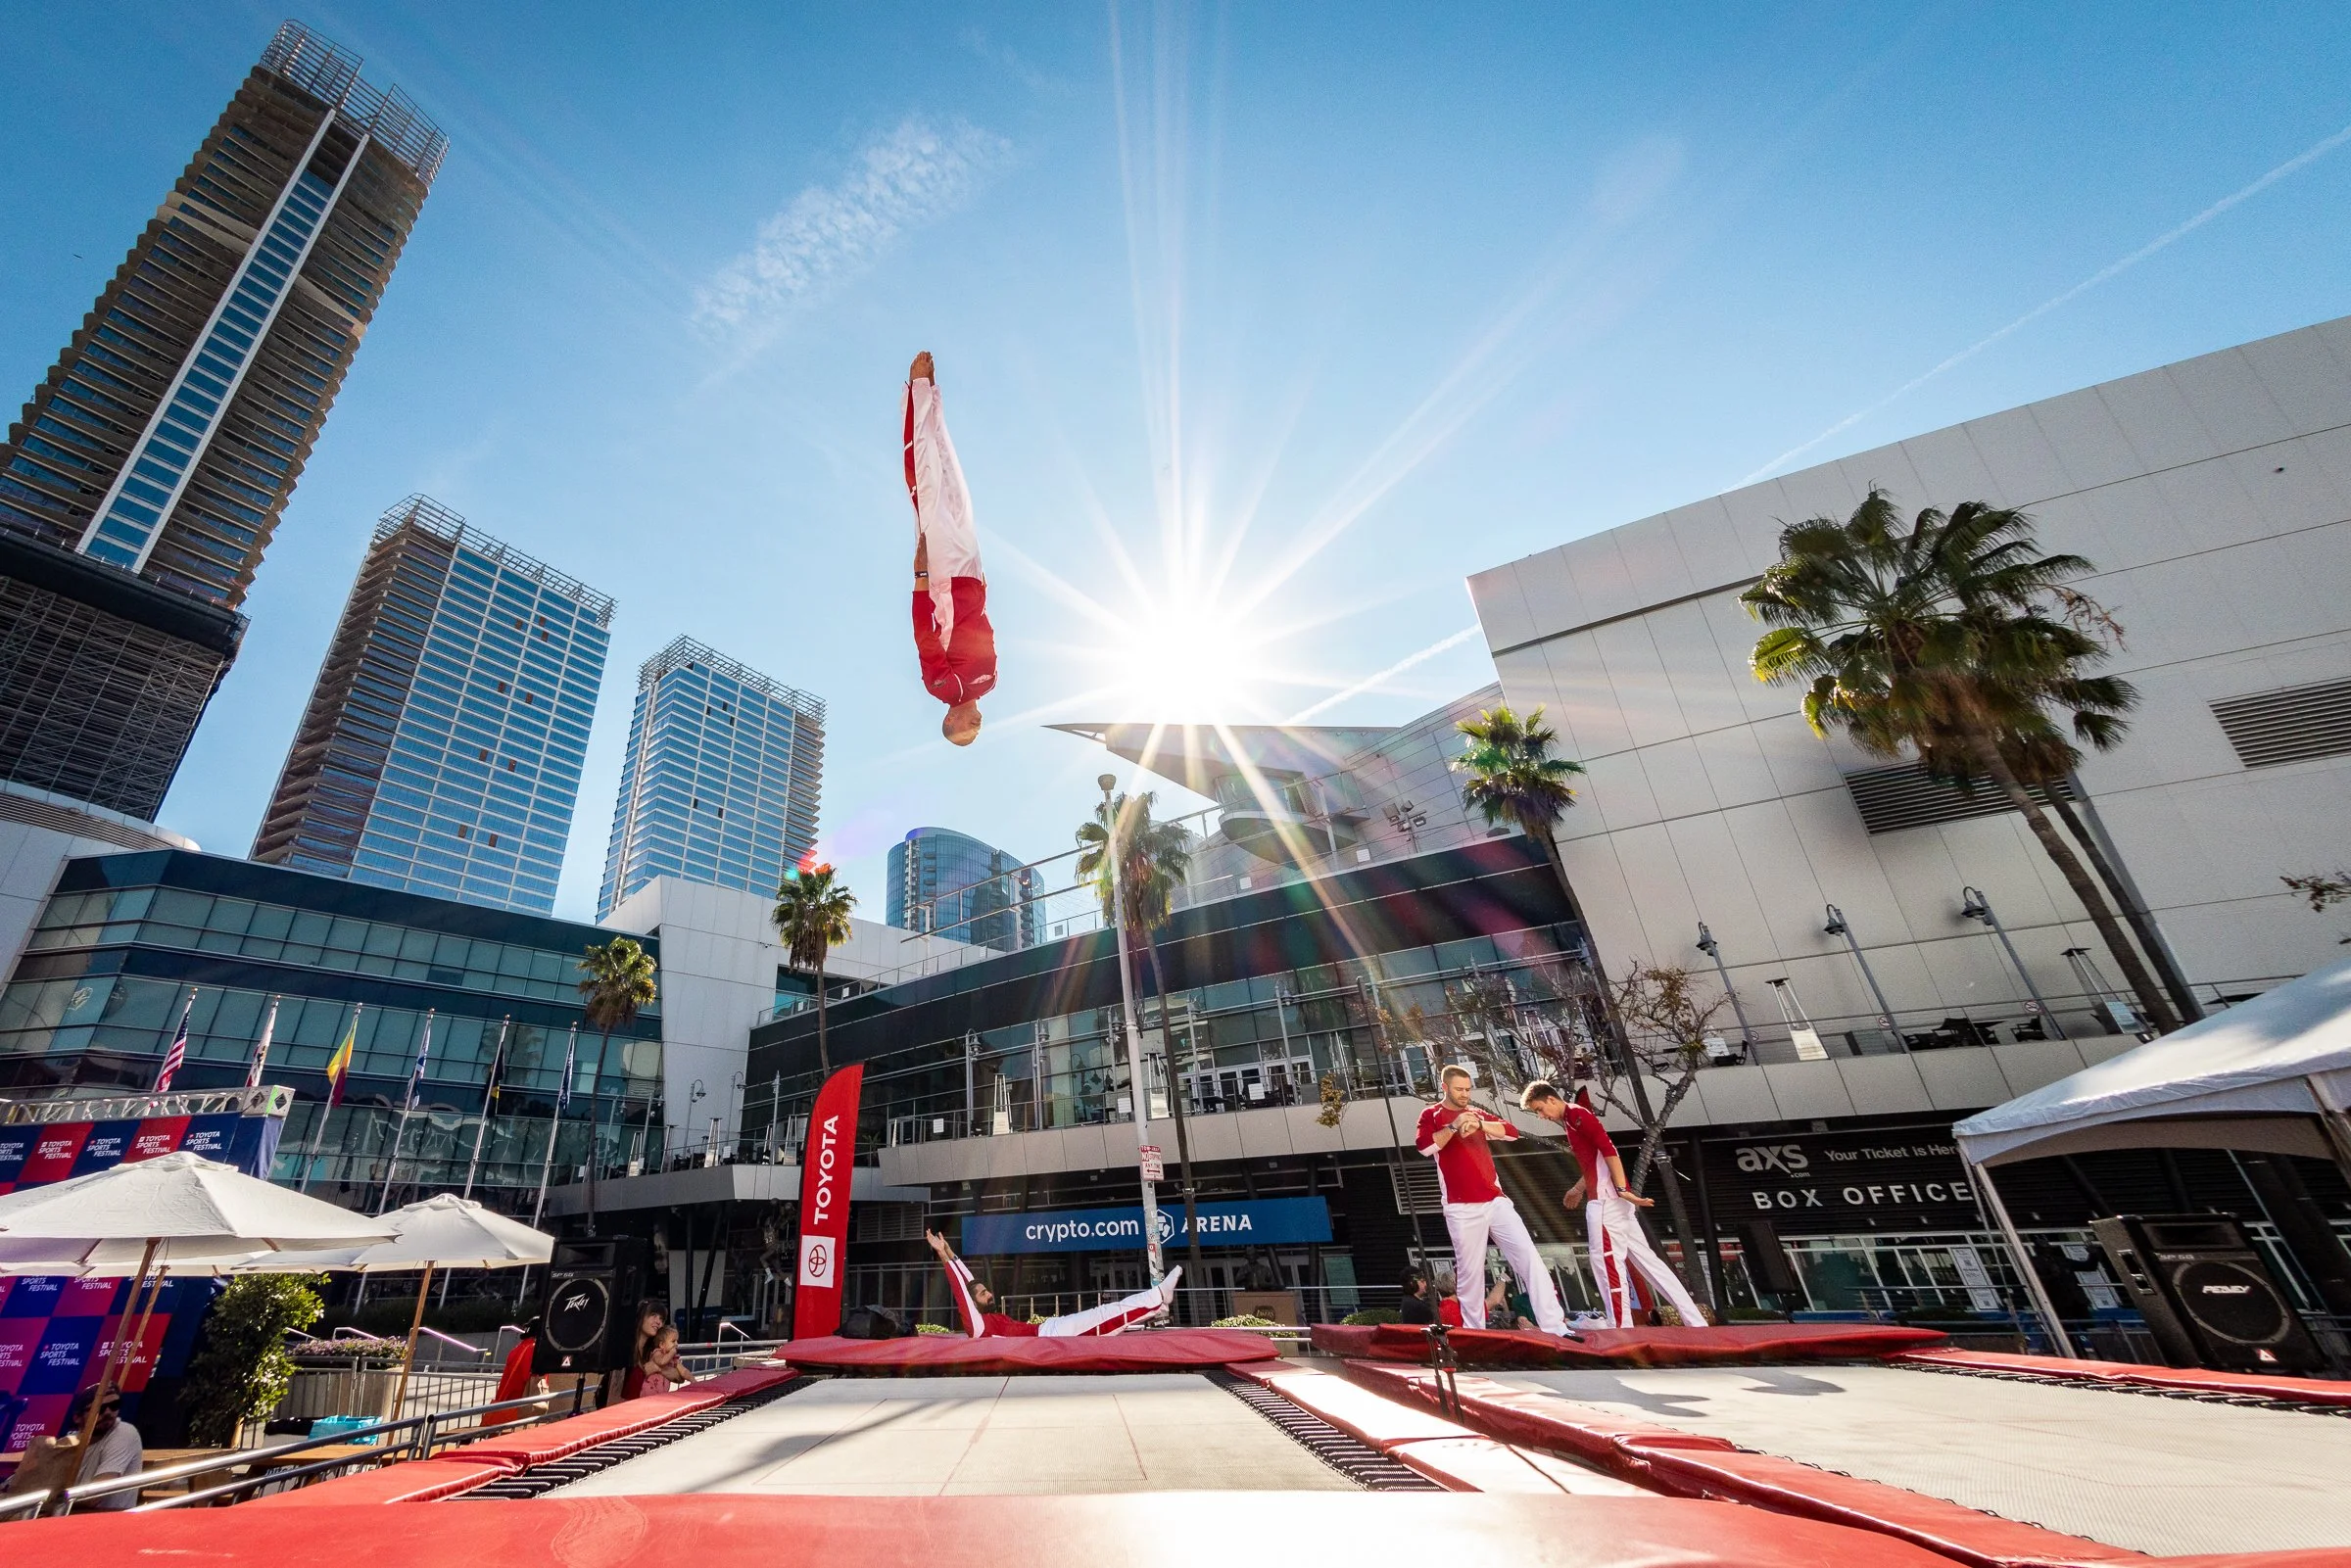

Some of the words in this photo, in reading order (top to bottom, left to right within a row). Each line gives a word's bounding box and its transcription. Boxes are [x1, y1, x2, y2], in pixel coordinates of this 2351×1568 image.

[1823, 1149, 1858, 1162] Your
[1861, 1146, 1909, 1160] Ticket
[814, 1115, 840, 1225] TOYOTA
[1751, 1189, 1823, 1210] BOX
[1843, 1181, 1974, 1205] OFFICE
[1026, 1219, 1139, 1243] crypto.com
[2202, 1285, 2250, 1294] PEAVEY
